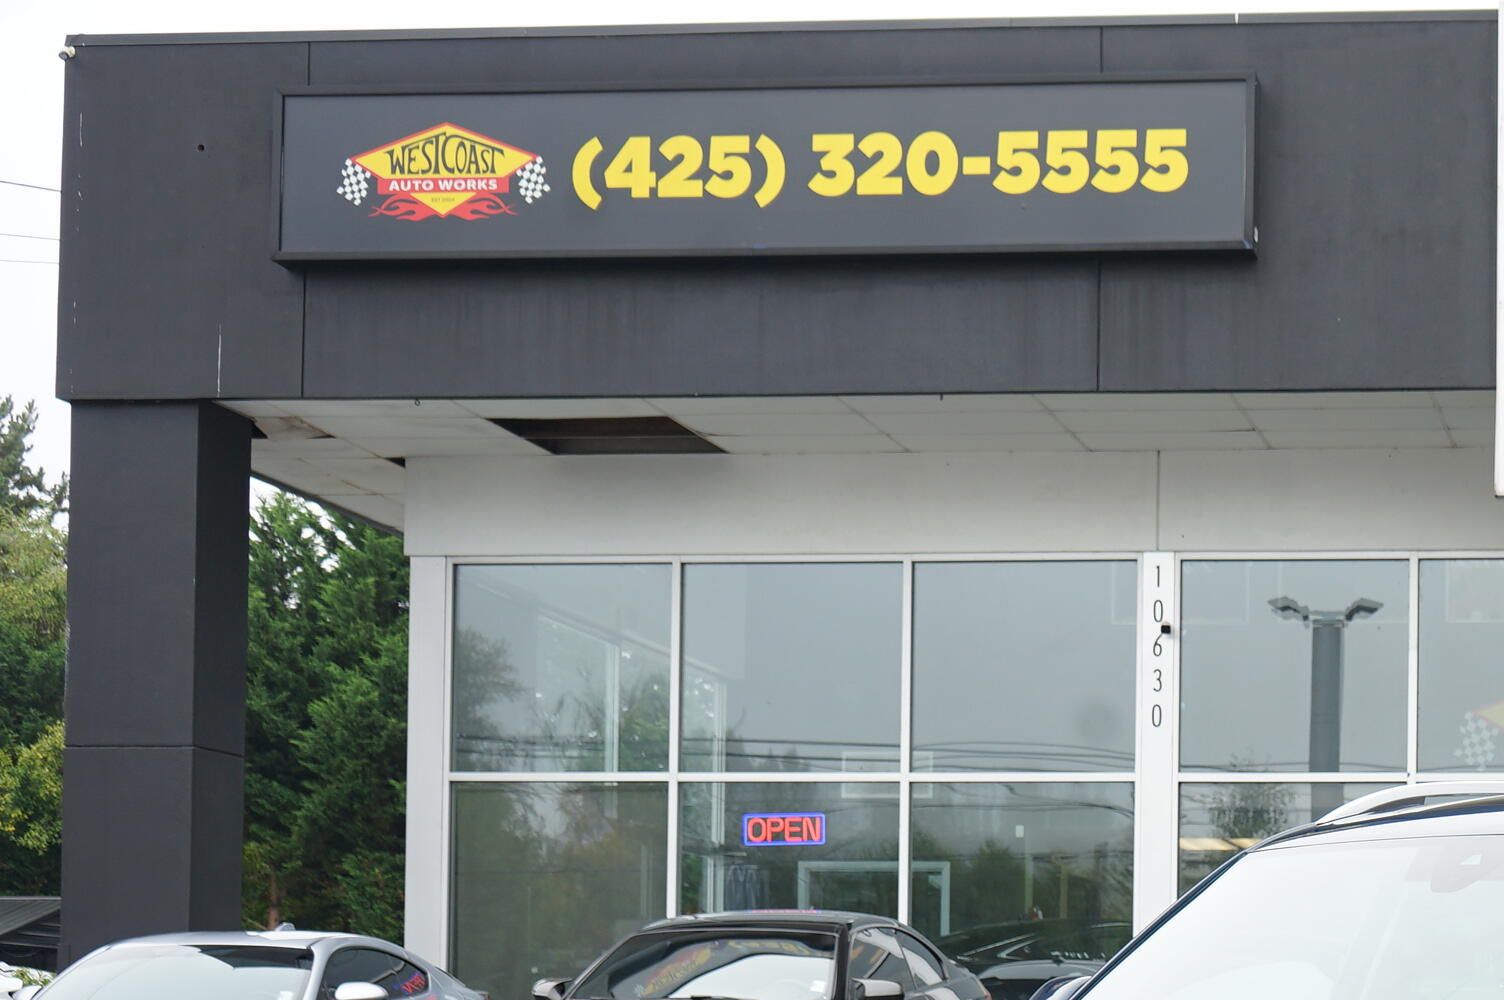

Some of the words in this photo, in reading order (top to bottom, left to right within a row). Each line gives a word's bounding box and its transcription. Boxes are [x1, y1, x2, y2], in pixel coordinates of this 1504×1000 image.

[571, 133, 786, 211] (425)
[807, 128, 1189, 198] 320-5555
[388, 180, 432, 192] AUTO
[438, 179, 498, 191] WORKS
[747, 816, 821, 843] OPEN
